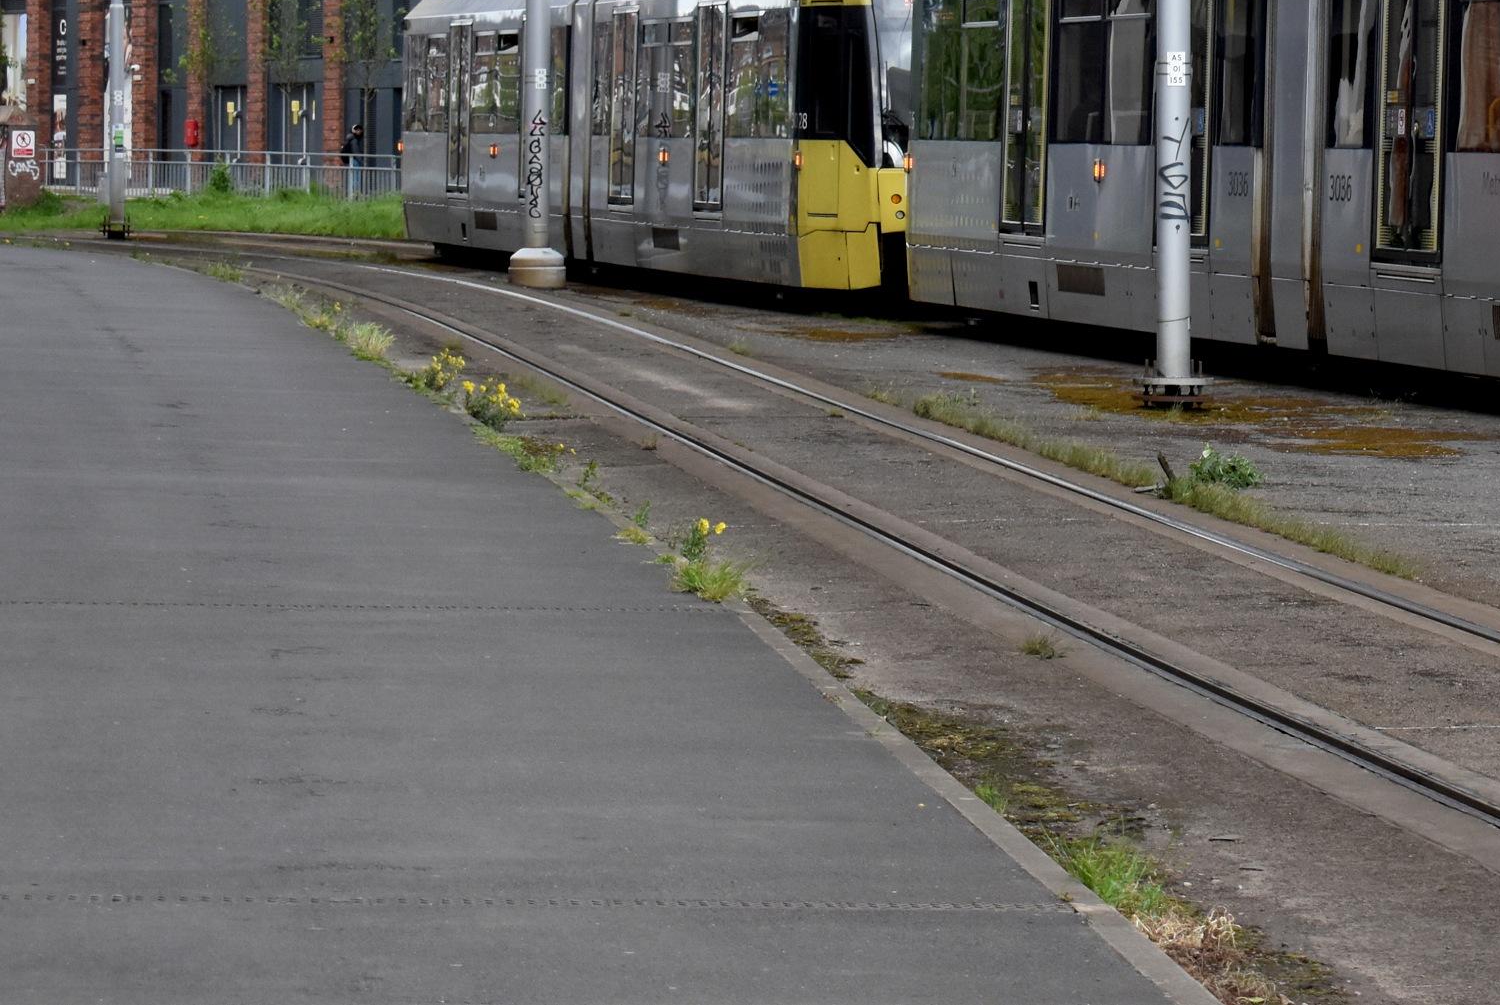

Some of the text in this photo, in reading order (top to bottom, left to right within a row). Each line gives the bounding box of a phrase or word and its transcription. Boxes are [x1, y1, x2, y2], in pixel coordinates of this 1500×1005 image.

[1169, 76, 1183, 84] 155
[1227, 171, 1249, 197] 3036
[1328, 174, 1353, 202] 3036
